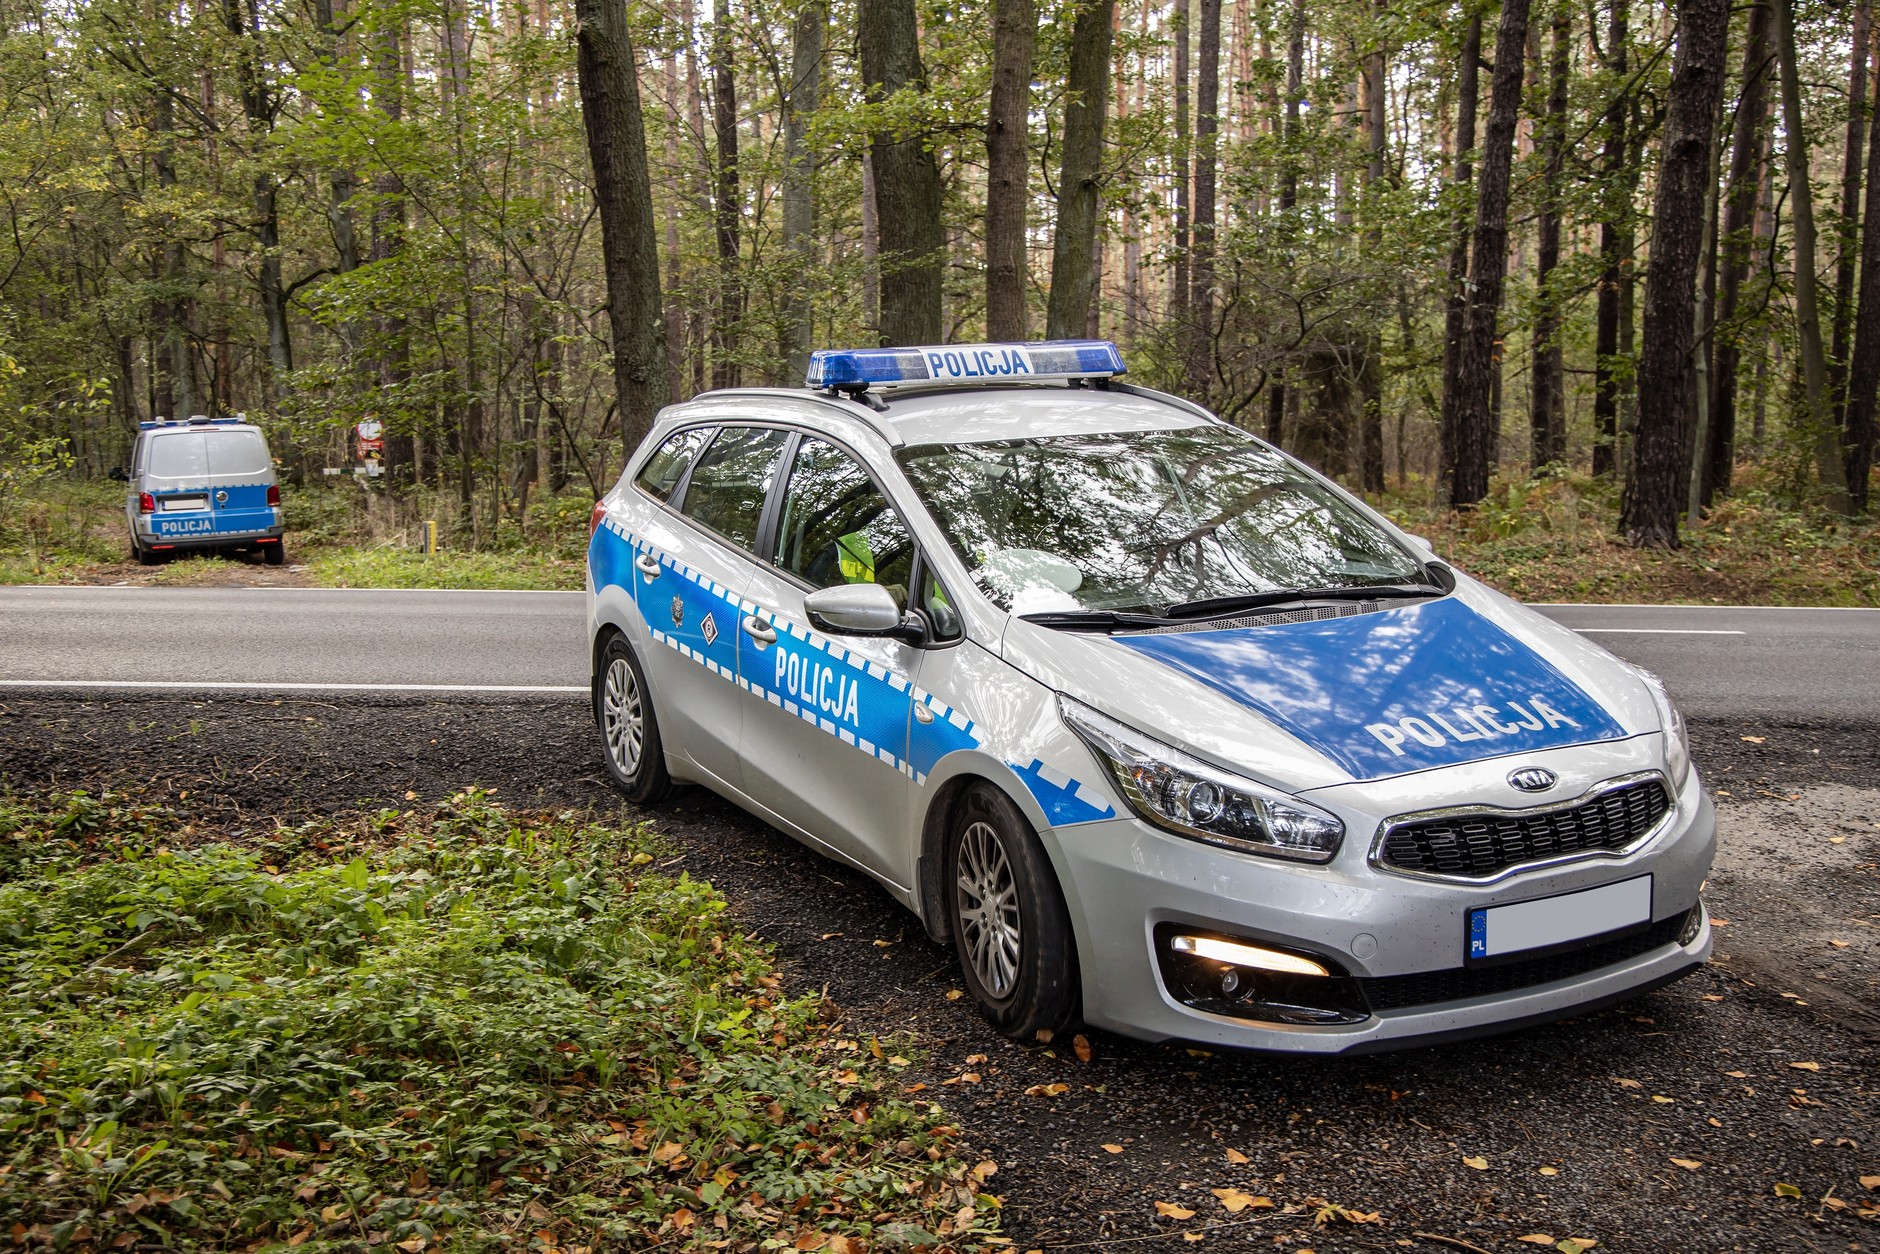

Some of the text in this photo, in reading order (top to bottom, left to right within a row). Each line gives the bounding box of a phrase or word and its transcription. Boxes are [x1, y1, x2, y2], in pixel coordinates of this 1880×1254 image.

[930, 350, 1029, 377] POLICJA
[161, 519, 212, 533] POLICJA
[1121, 534, 1151, 545] OLICJA
[775, 646, 858, 727] POLICJA
[1364, 698, 1577, 756] POLICJA
[1514, 770, 1554, 788] KIA
[1472, 939, 1485, 952] PL
